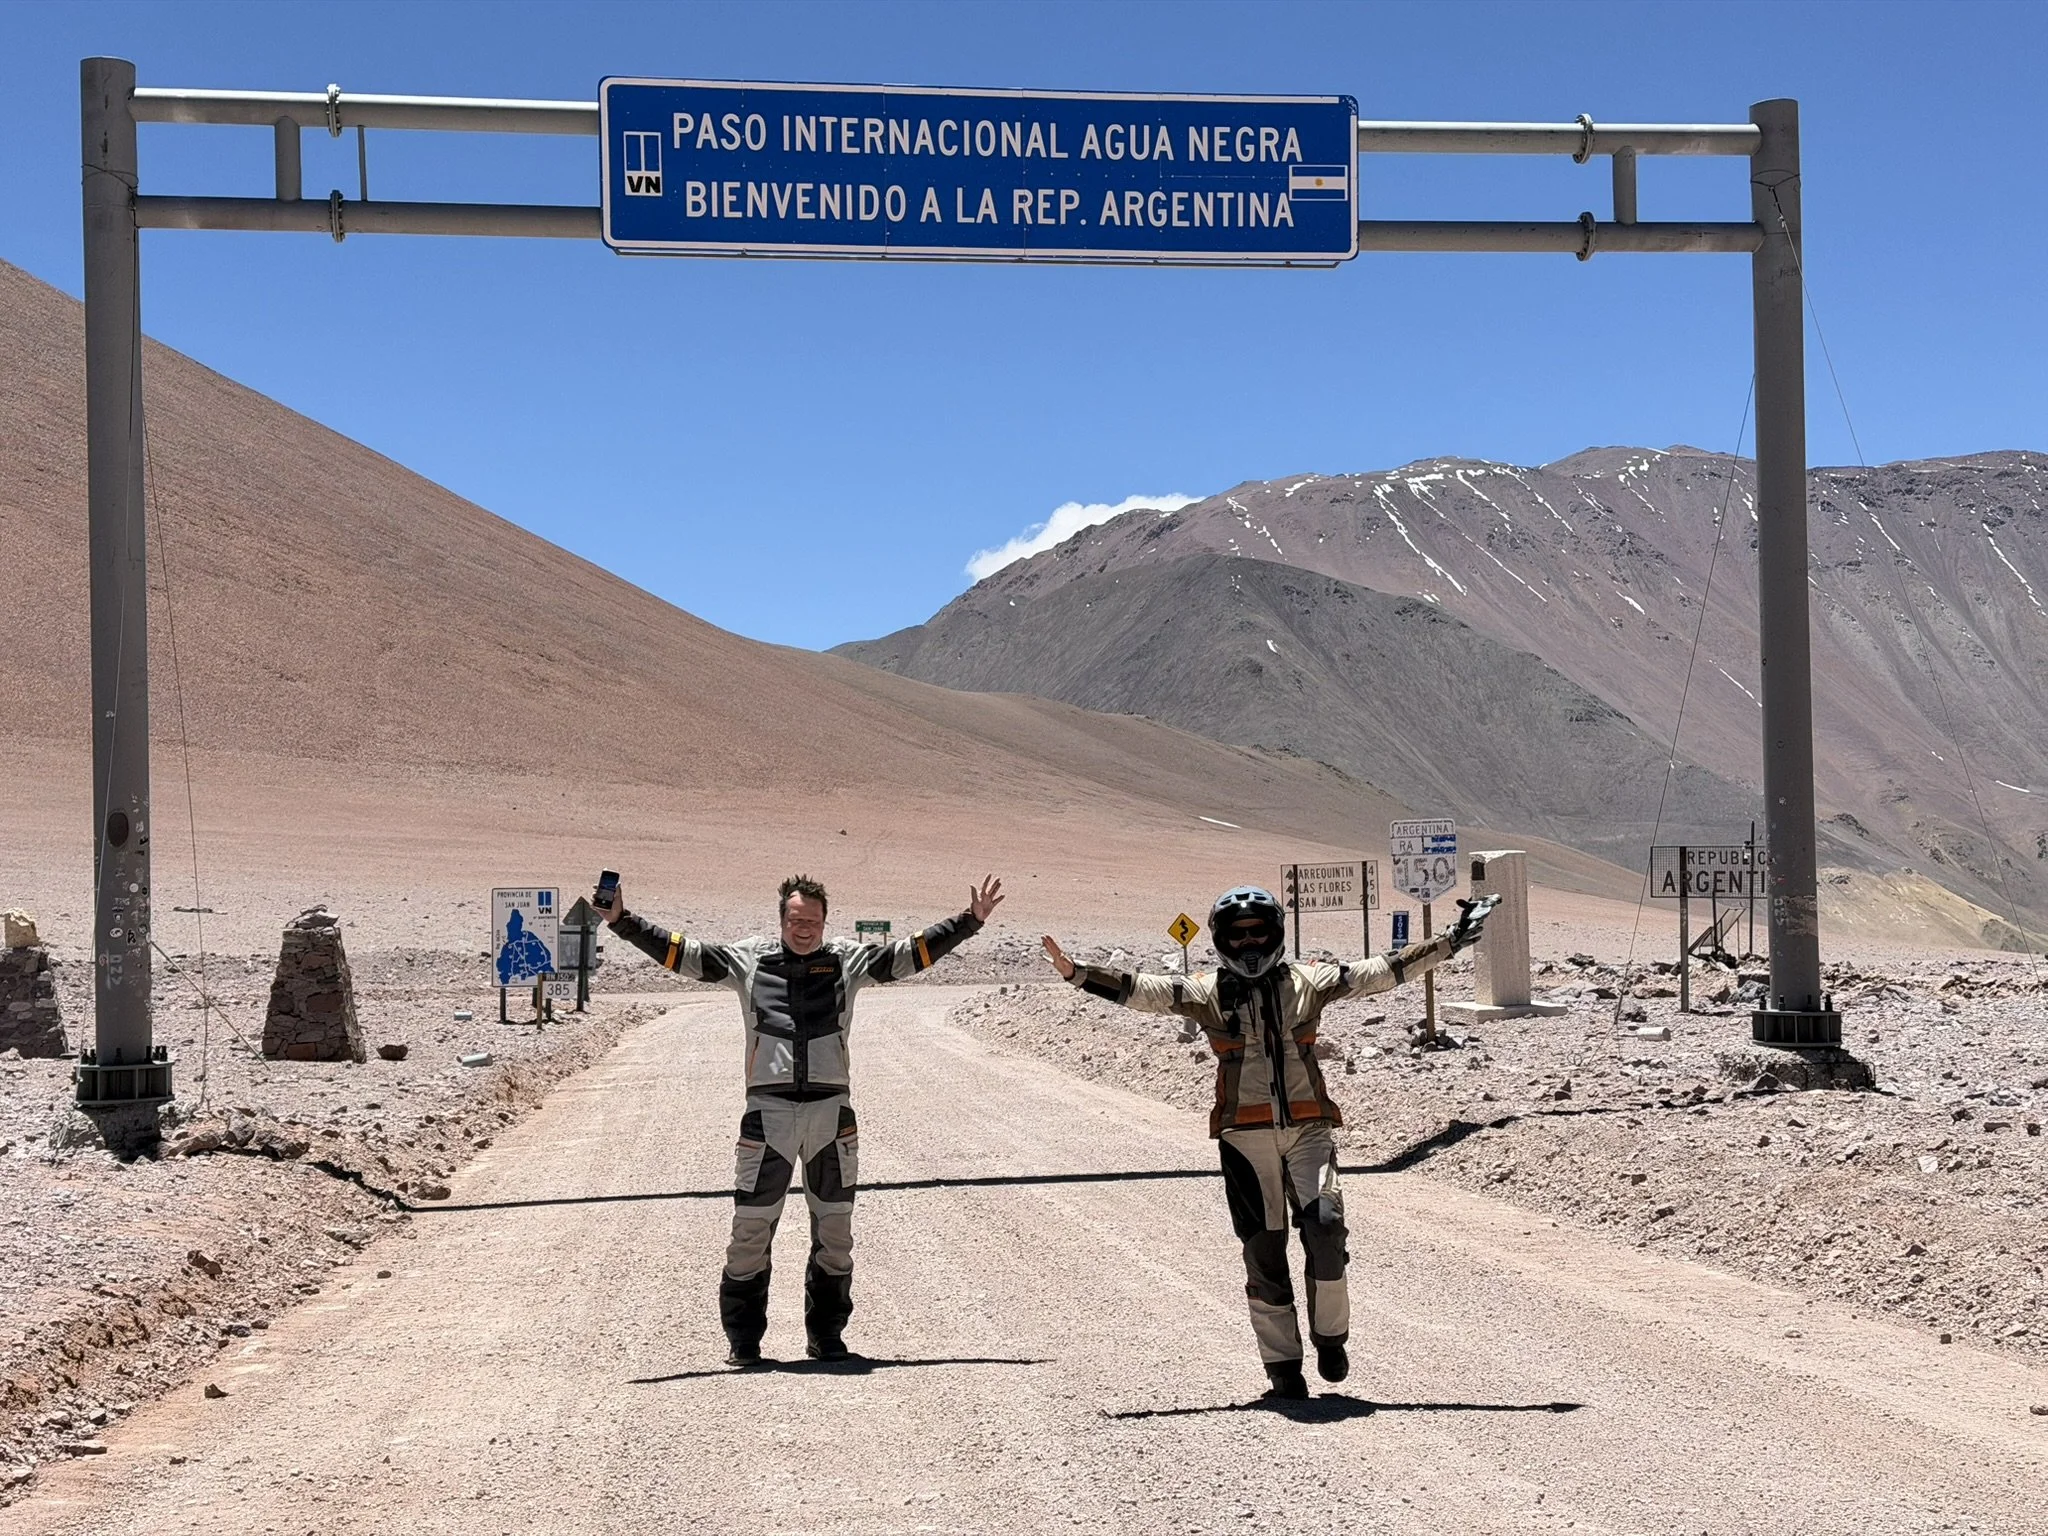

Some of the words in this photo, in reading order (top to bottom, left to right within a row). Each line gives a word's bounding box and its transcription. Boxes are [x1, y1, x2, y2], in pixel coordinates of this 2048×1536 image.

[673, 112, 767, 151] PASO
[783, 114, 1069, 159] INTERNACIONAL
[1080, 123, 1174, 161] AGUA
[1188, 126, 1303, 162] NEGRA
[626, 175, 661, 193] VN
[685, 180, 906, 222] BIENVENIDO
[919, 187, 942, 223] A
[956, 187, 998, 224] LA
[1012, 188, 1087, 225] REP.
[1099, 190, 1294, 228] ARGENTINA
[1396, 823, 1449, 836] ARGENTINA
[1399, 840, 1413, 851] RA
[1687, 850, 1766, 865] REPUBLC
[1298, 866, 1354, 879] ARREQUINTIN
[1402, 856, 1450, 886] 150
[1298, 882, 1316, 894] LAS
[1318, 881, 1352, 893] FLORES
[1661, 870, 1766, 894] ARGENTI
[504, 901, 515, 909] SAN
[1299, 896, 1317, 908] SAN
[1319, 895, 1344, 907] JUAN
[547, 983, 570, 996] 385
